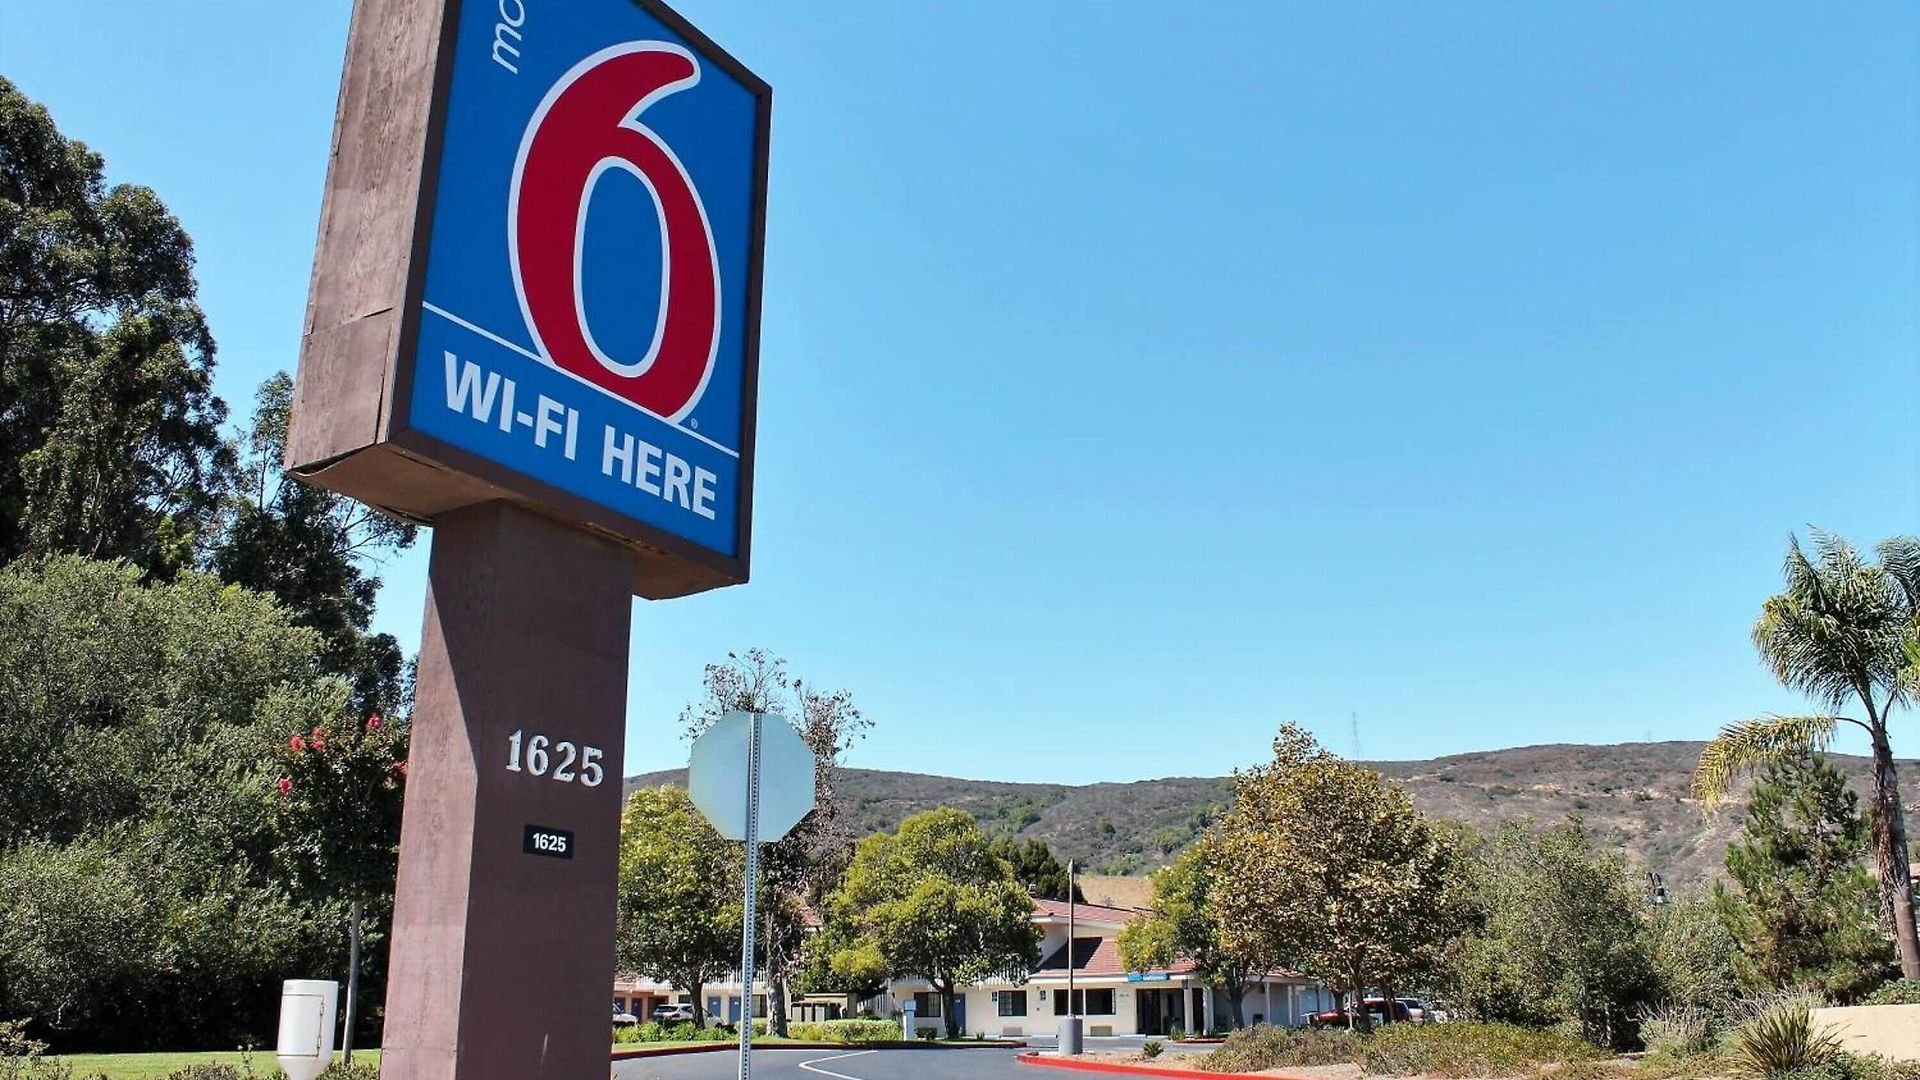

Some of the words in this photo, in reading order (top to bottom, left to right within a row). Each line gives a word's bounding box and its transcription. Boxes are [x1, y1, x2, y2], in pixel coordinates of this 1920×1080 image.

[507, 40, 722, 425] 6
[444, 351, 579, 461] WI-FI
[602, 425, 717, 521] HERE
[505, 729, 604, 787] 1625
[532, 832, 567, 853] 1625
